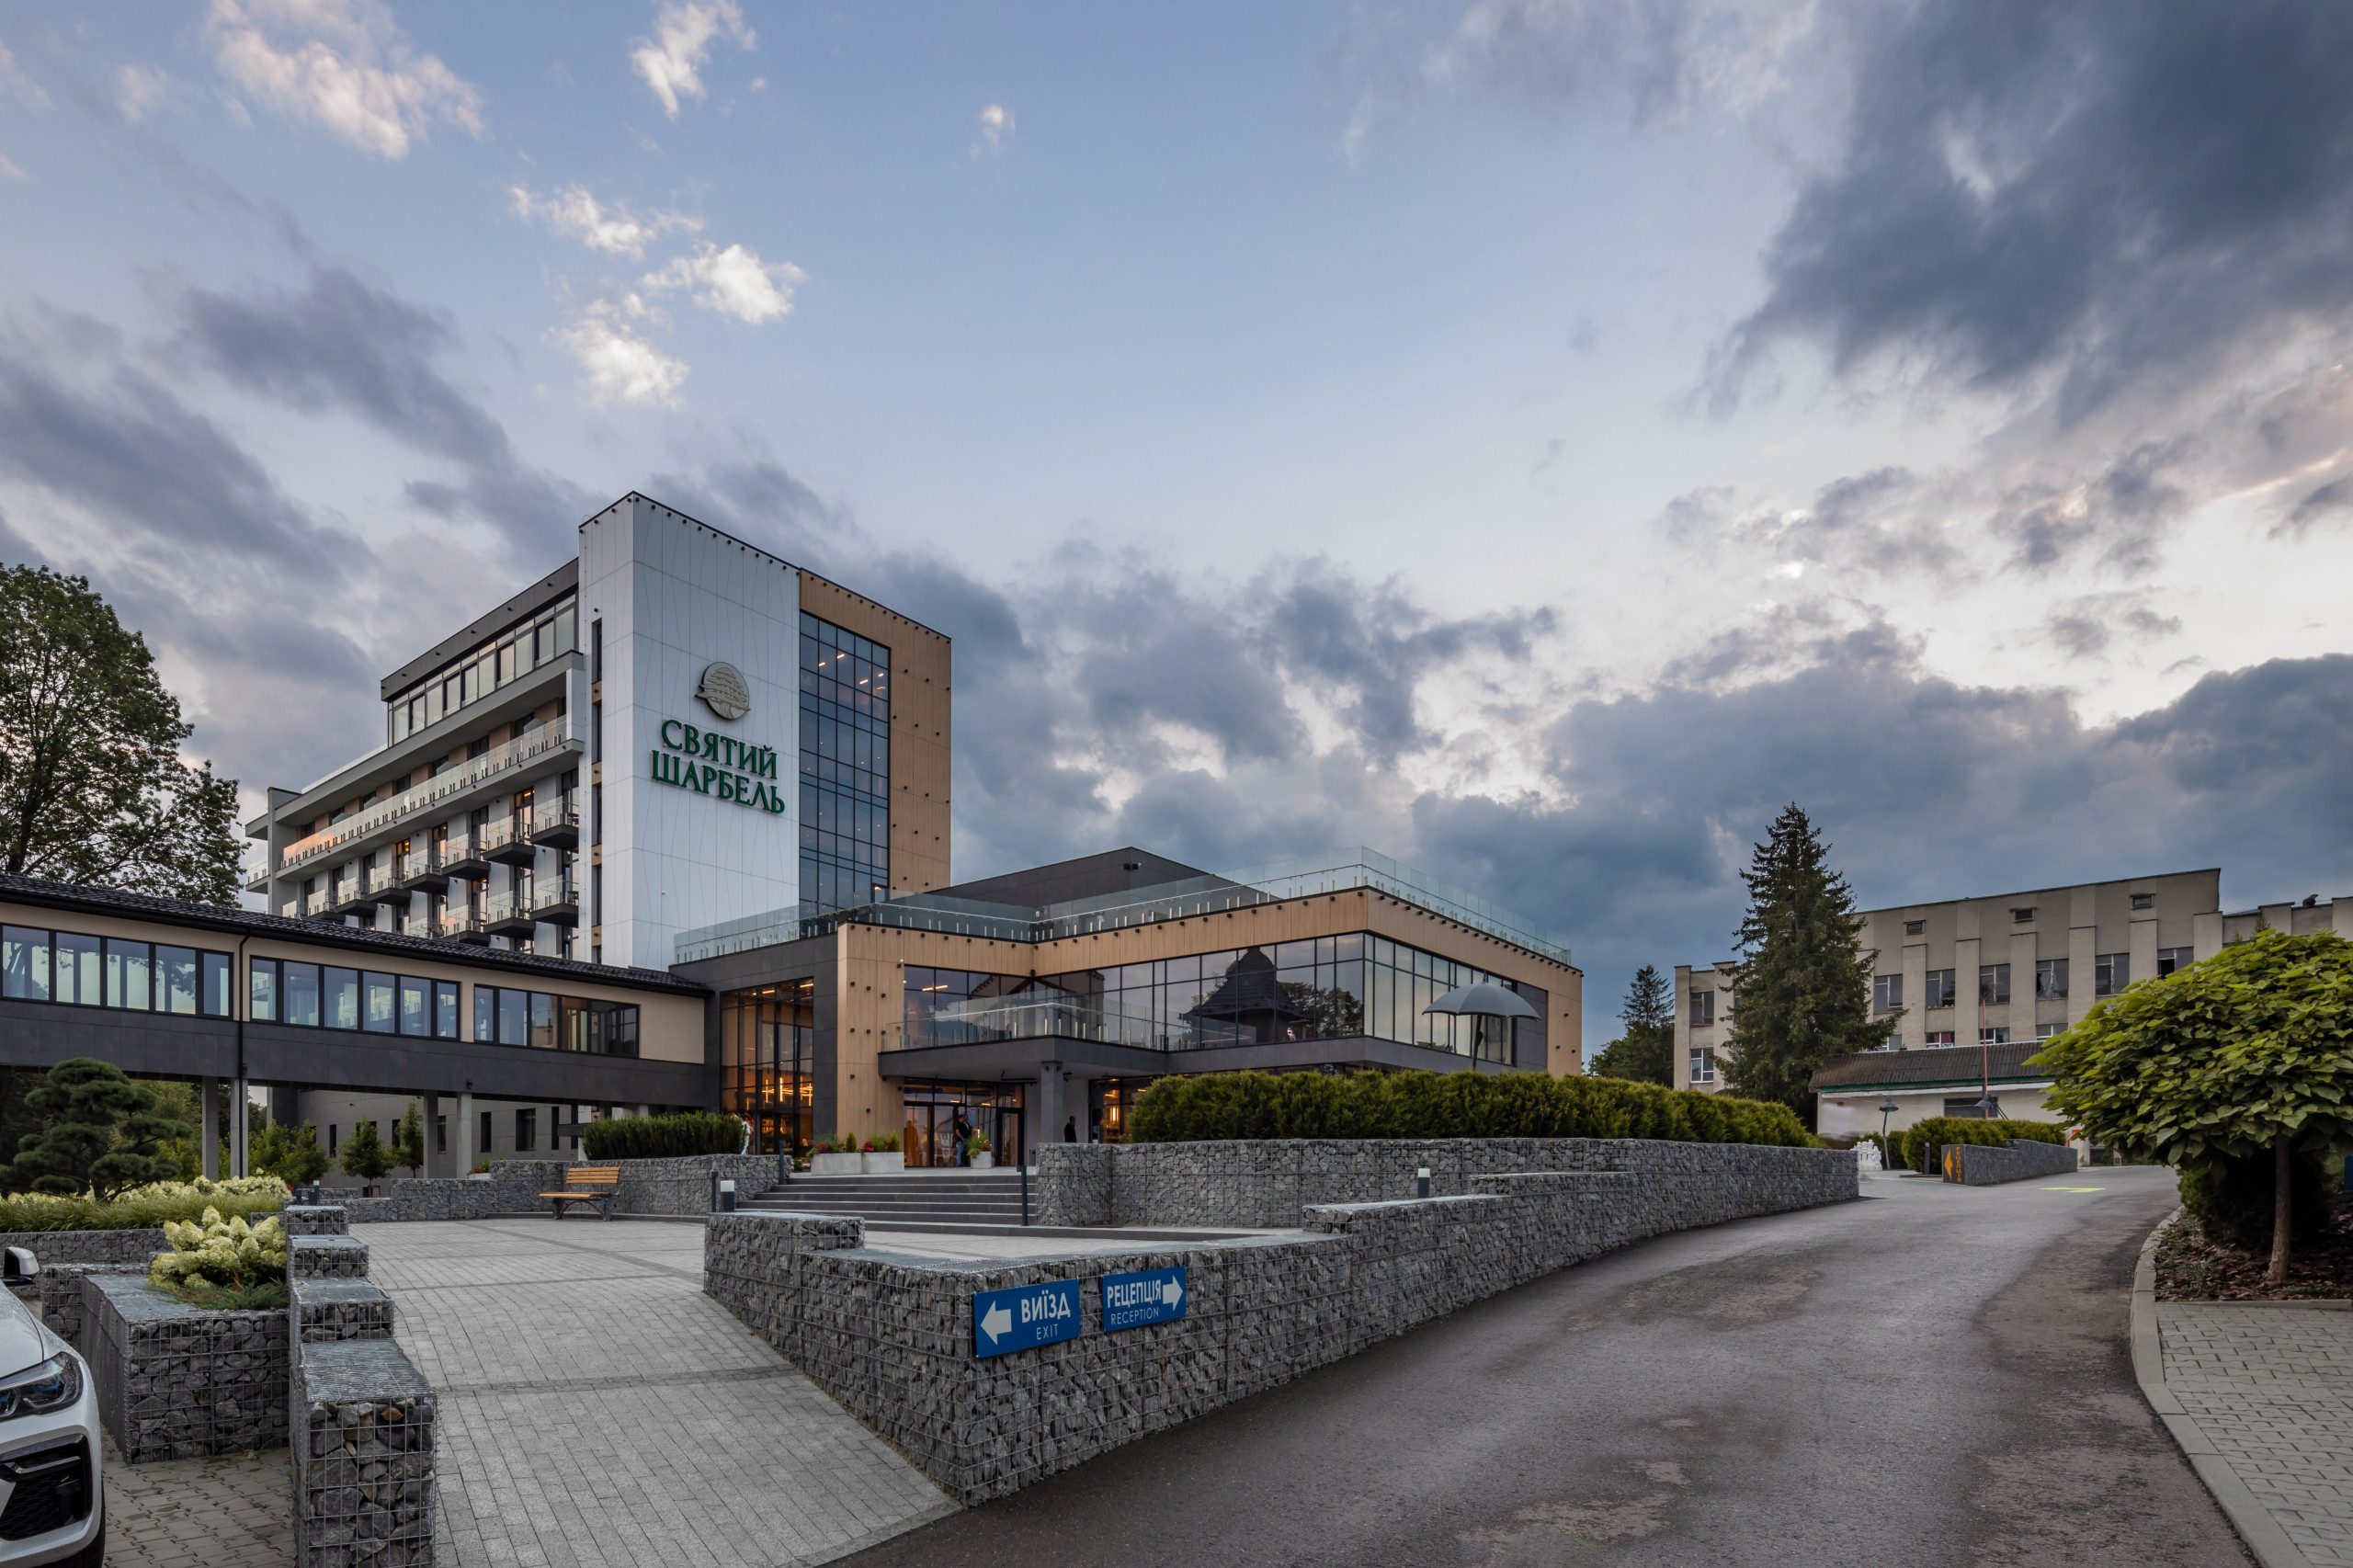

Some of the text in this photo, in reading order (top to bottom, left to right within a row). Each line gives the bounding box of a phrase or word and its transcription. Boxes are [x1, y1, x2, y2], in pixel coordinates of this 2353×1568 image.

[662, 720, 778, 779] СВЯТИЙ
[652, 750, 785, 813] ШАРБЕЛЬ
[1021, 1290, 1071, 1324] ВИЇЗД
[1107, 1278, 1162, 1308] РЕЦЕПЦІЯ
[1110, 1306, 1159, 1325] RECEPTION
[1036, 1324, 1058, 1340] EXIT
